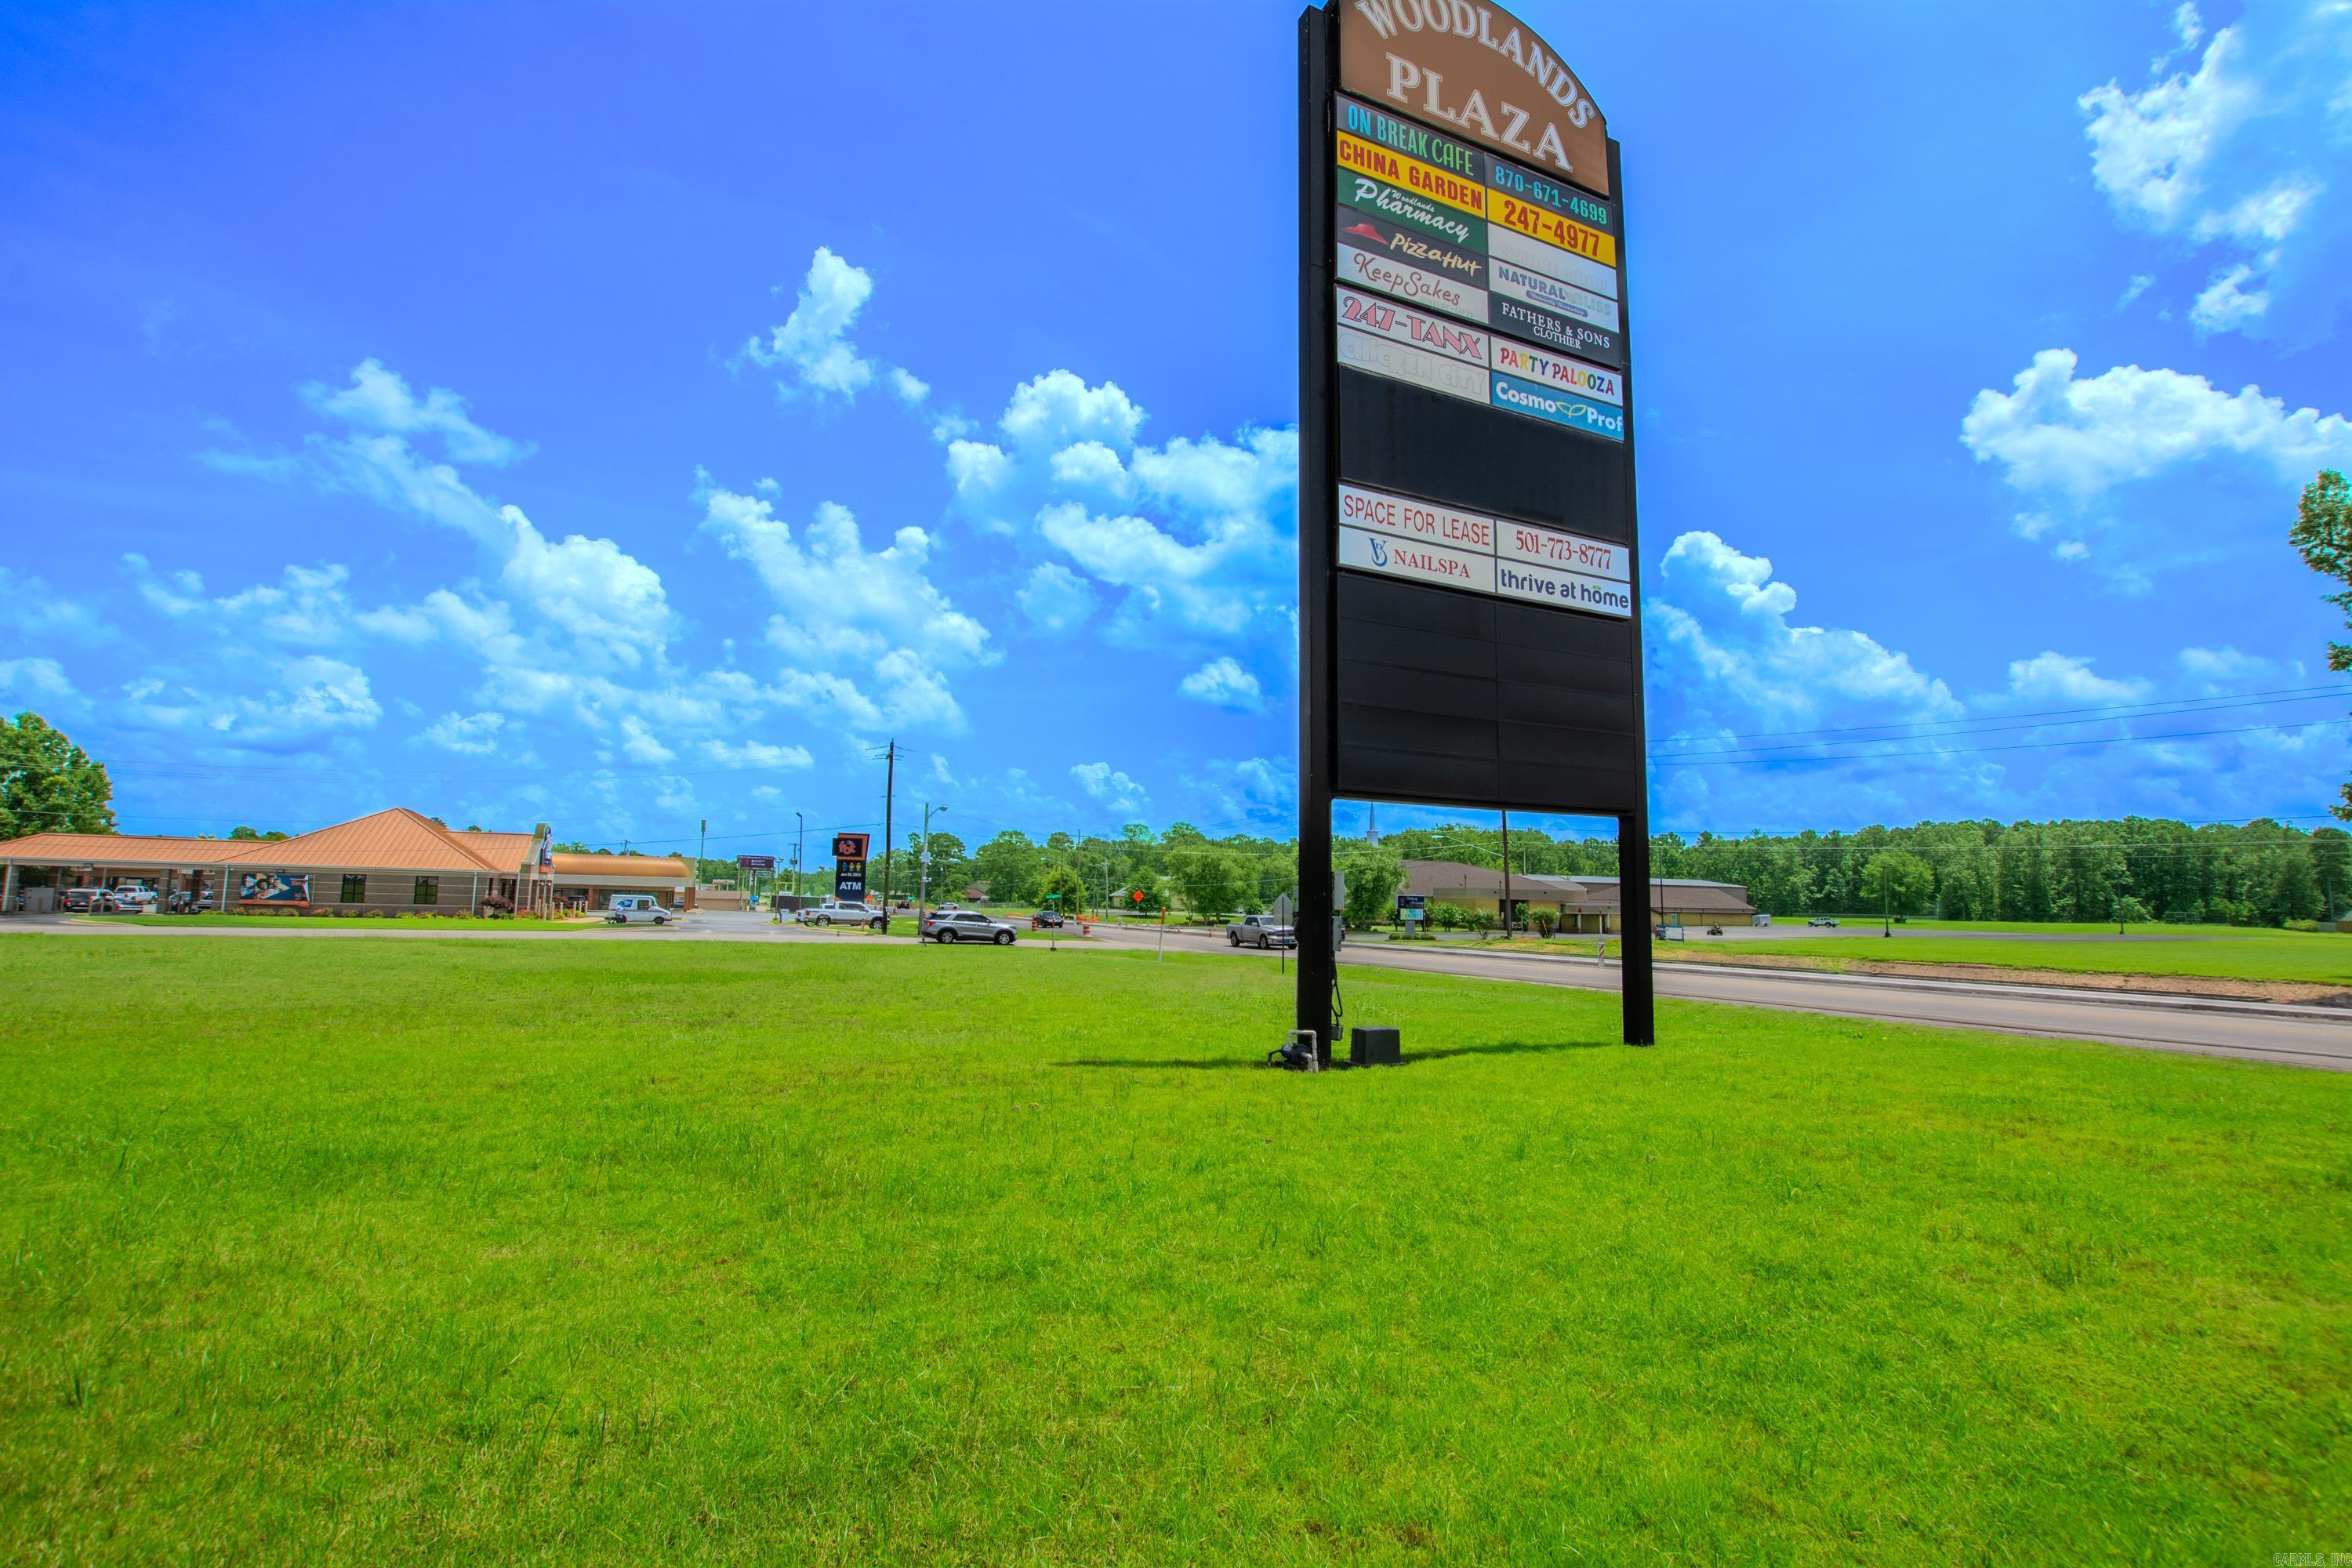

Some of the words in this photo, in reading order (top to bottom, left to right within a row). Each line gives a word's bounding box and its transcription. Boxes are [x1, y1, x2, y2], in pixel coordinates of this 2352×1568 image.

[1355, 0, 1596, 129] WOODLANDS
[1386, 53, 1573, 172] PLAZA
[1348, 104, 1370, 136] ON
[1377, 114, 1428, 158] BREAK
[1432, 138, 1474, 176] CAFE
[1339, 140, 1399, 180] CHINA
[1409, 165, 1482, 210] GARDEN
[1391, 189, 1434, 212] Woodlands
[1495, 165, 1606, 225] 870-671-4699
[1355, 178, 1470, 243] Pharmacy
[1504, 200, 1599, 257] 247-4977
[1354, 252, 1460, 306] KeepSakes
[1498, 267, 1566, 300] NATURAL
[1342, 296, 1482, 360] 247-TANX
[1501, 302, 1561, 332] FATHERS
[1566, 326, 1573, 336] &
[1577, 328, 1610, 348] SONS
[1533, 326, 1581, 349] CLOTHIER
[1500, 347, 1549, 376] PARTY
[1552, 363, 1614, 396] PALOOZA
[1496, 381, 1556, 412] Cosmo
[1587, 406, 1623, 431] Prof
[1344, 494, 1396, 526] SPACE
[1404, 508, 1435, 535] FOR
[1443, 516, 1490, 546] LEASE
[1393, 549, 1471, 578] NAILSPA
[1515, 529, 1611, 569] 501-773-8777
[1501, 568, 1555, 595] thrive
[1560, 582, 1577, 599] at
[1581, 583, 1629, 609] home
[839, 881, 862, 890] ATM
